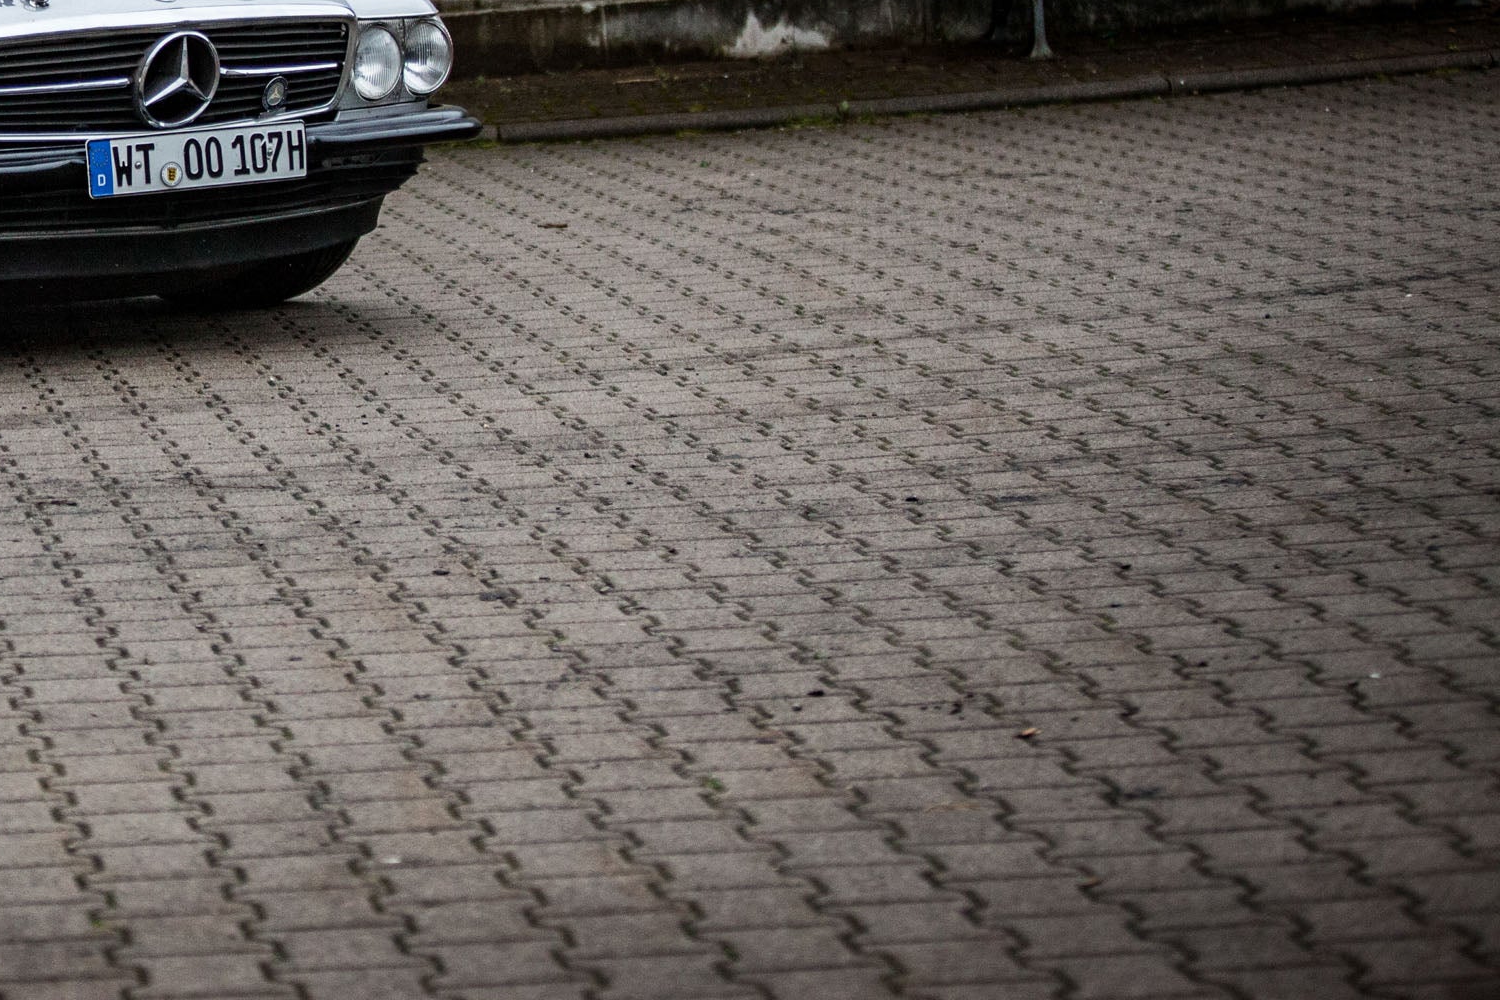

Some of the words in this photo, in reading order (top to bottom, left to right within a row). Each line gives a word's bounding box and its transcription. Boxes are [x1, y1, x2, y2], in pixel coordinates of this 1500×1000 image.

[112, 143, 155, 187] WT
[231, 129, 305, 176] 107H
[97, 174, 106, 187] D
